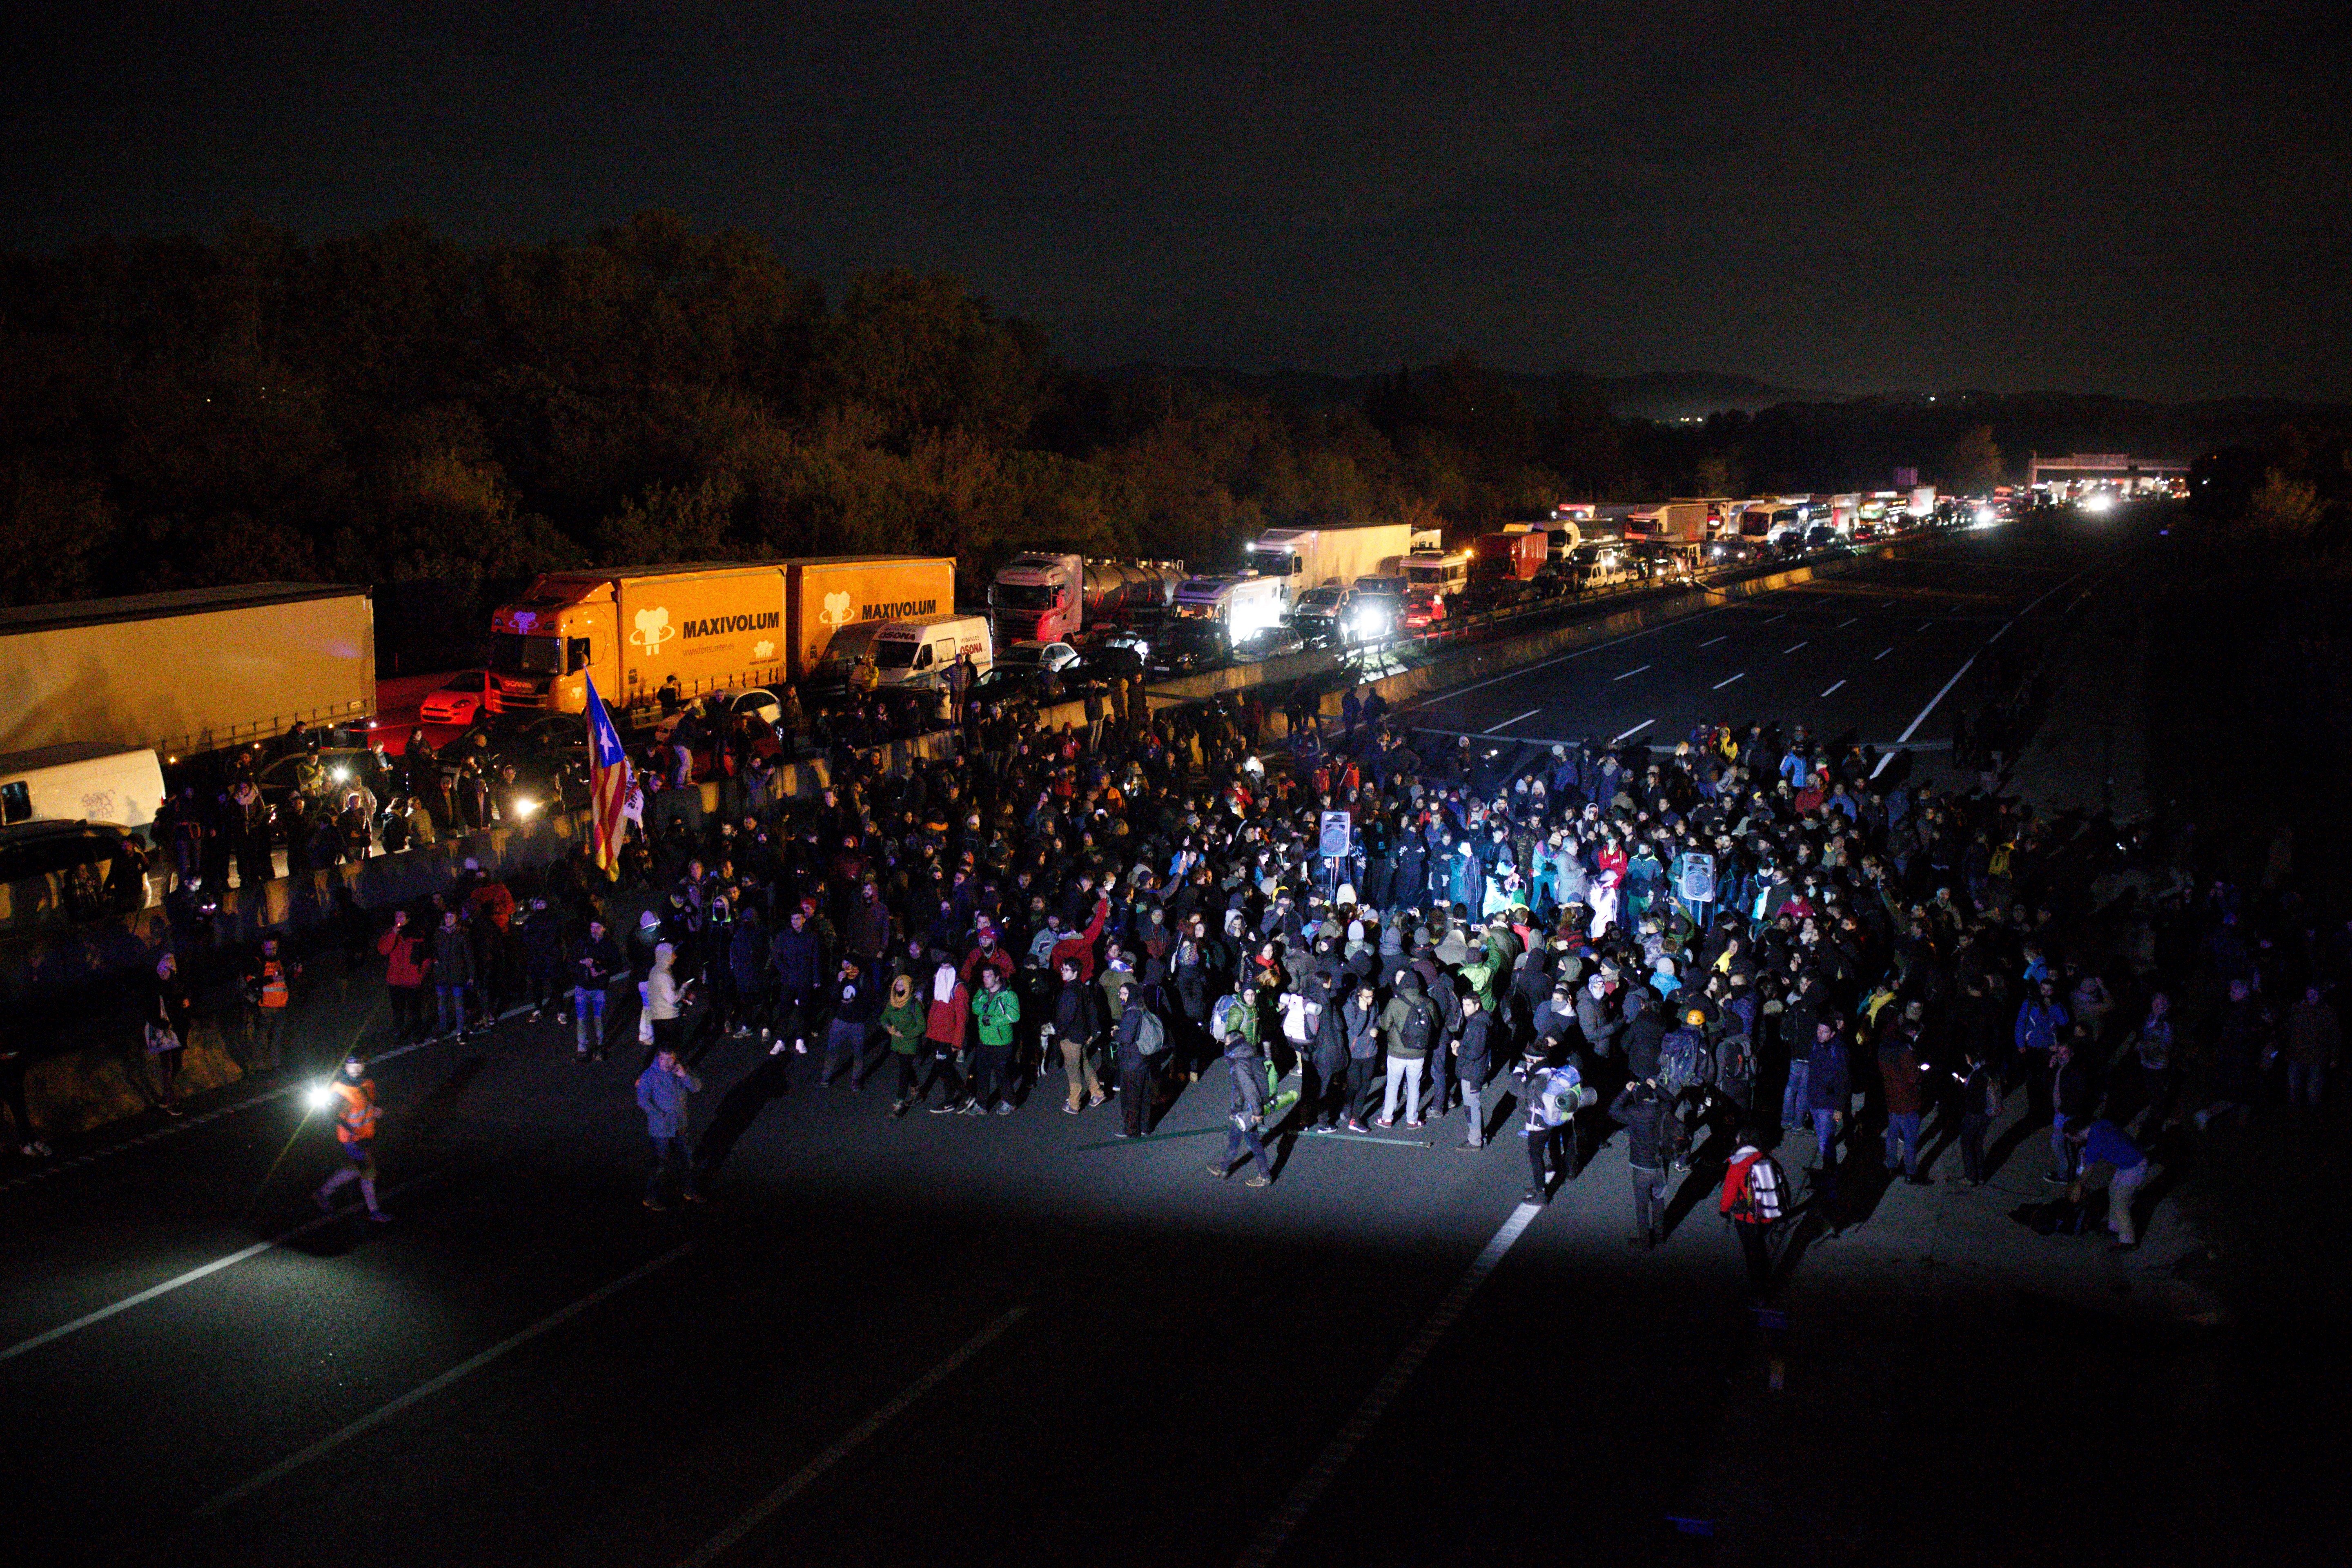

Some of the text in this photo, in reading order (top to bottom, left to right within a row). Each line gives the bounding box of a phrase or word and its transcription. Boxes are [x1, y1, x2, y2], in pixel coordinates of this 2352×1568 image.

[862, 599, 936, 620] MAXIVOLUM
[683, 612, 779, 639] MAXIVOLUM
[879, 631, 915, 641] OSONA
[683, 643, 734, 656] www.fortsumter.es
[960, 643, 982, 656] OSONA
[504, 680, 532, 688] SCANIA
